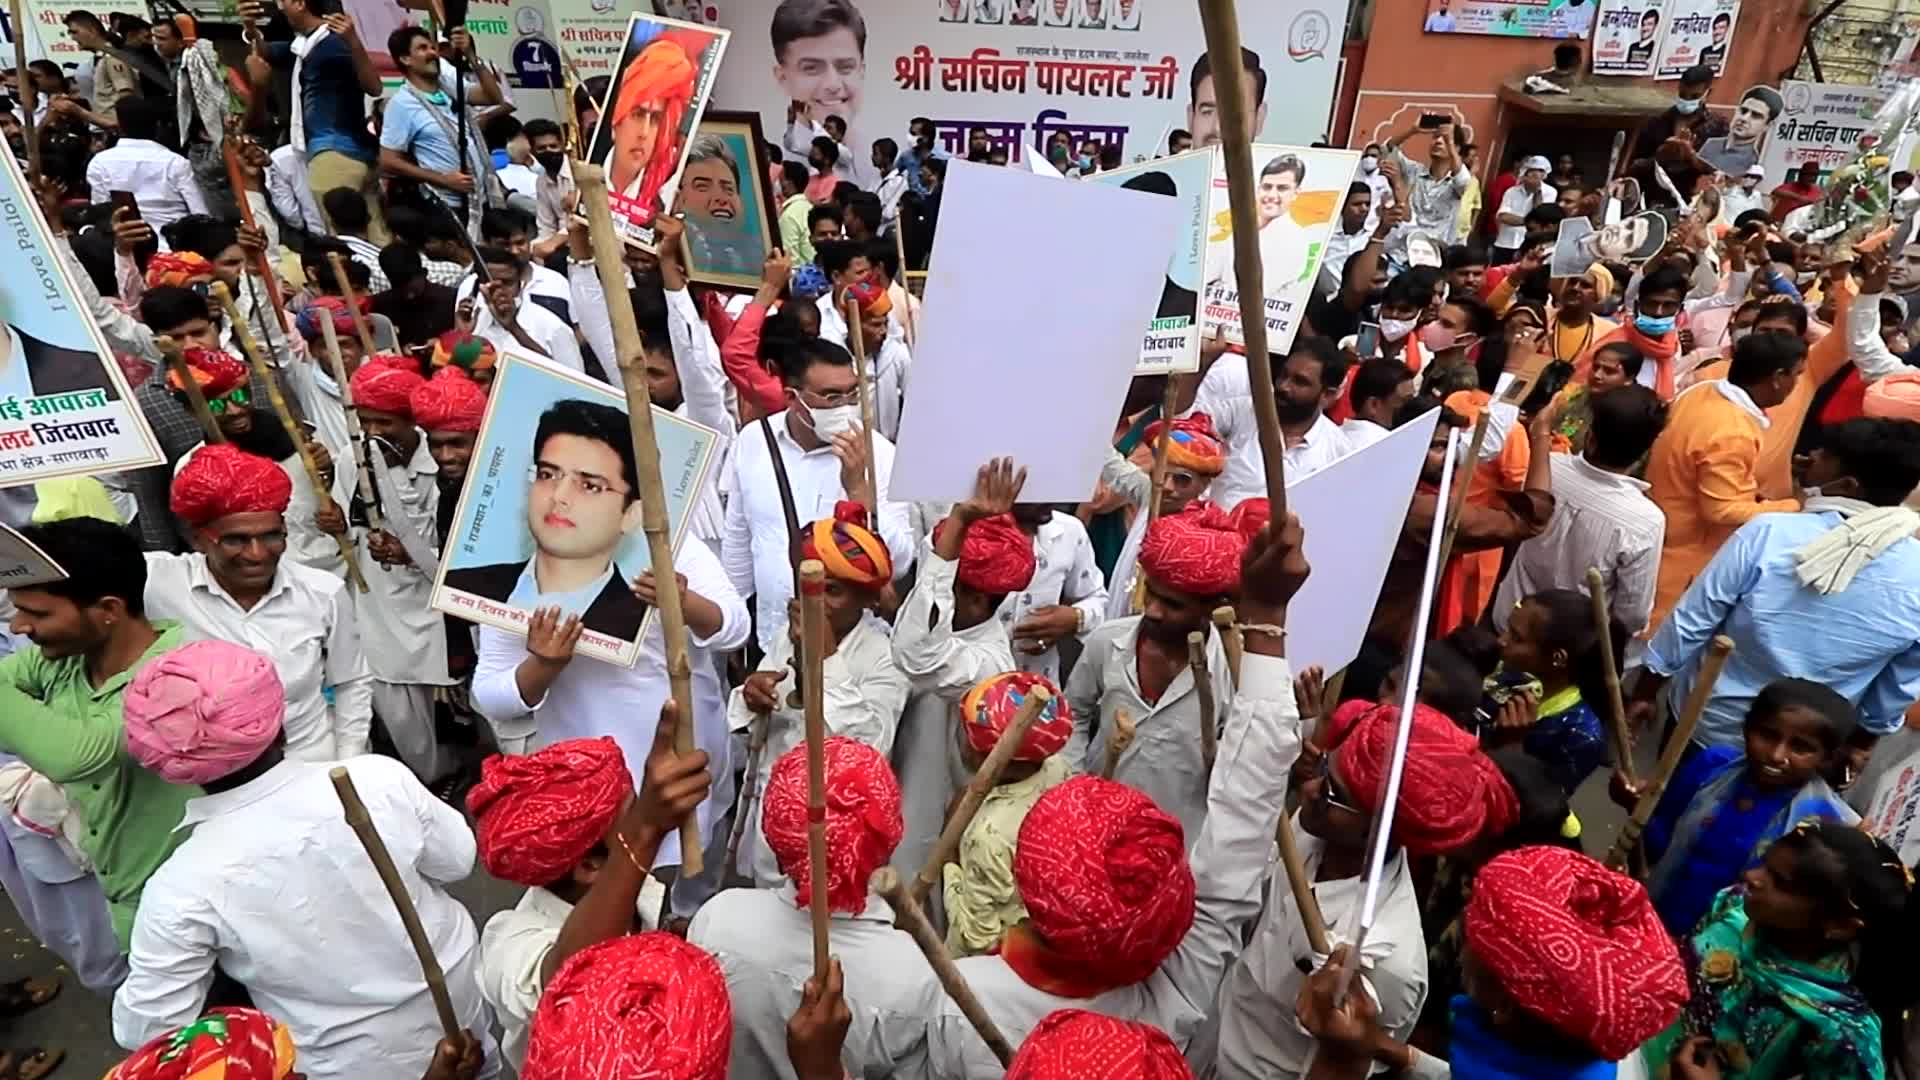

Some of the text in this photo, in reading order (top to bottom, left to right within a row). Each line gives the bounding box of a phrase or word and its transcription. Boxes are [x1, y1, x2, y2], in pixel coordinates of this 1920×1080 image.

[527, 41, 540, 63] 7
[895, 45, 1179, 100] श्री सचिन पायलट जी
[1776, 119, 1797, 141] श्री
[1797, 121, 1838, 144] सचिन
[31, 254, 61, 300] Love
[1143, 333, 1186, 351] जिंदाबाद
[26, 390, 108, 417] आवाज
[31, 418, 121, 446] जिंदाबाद
[450, 592, 475, 608] जन्म
[477, 599, 507, 619] दिवस
[508, 608, 527, 624] की
